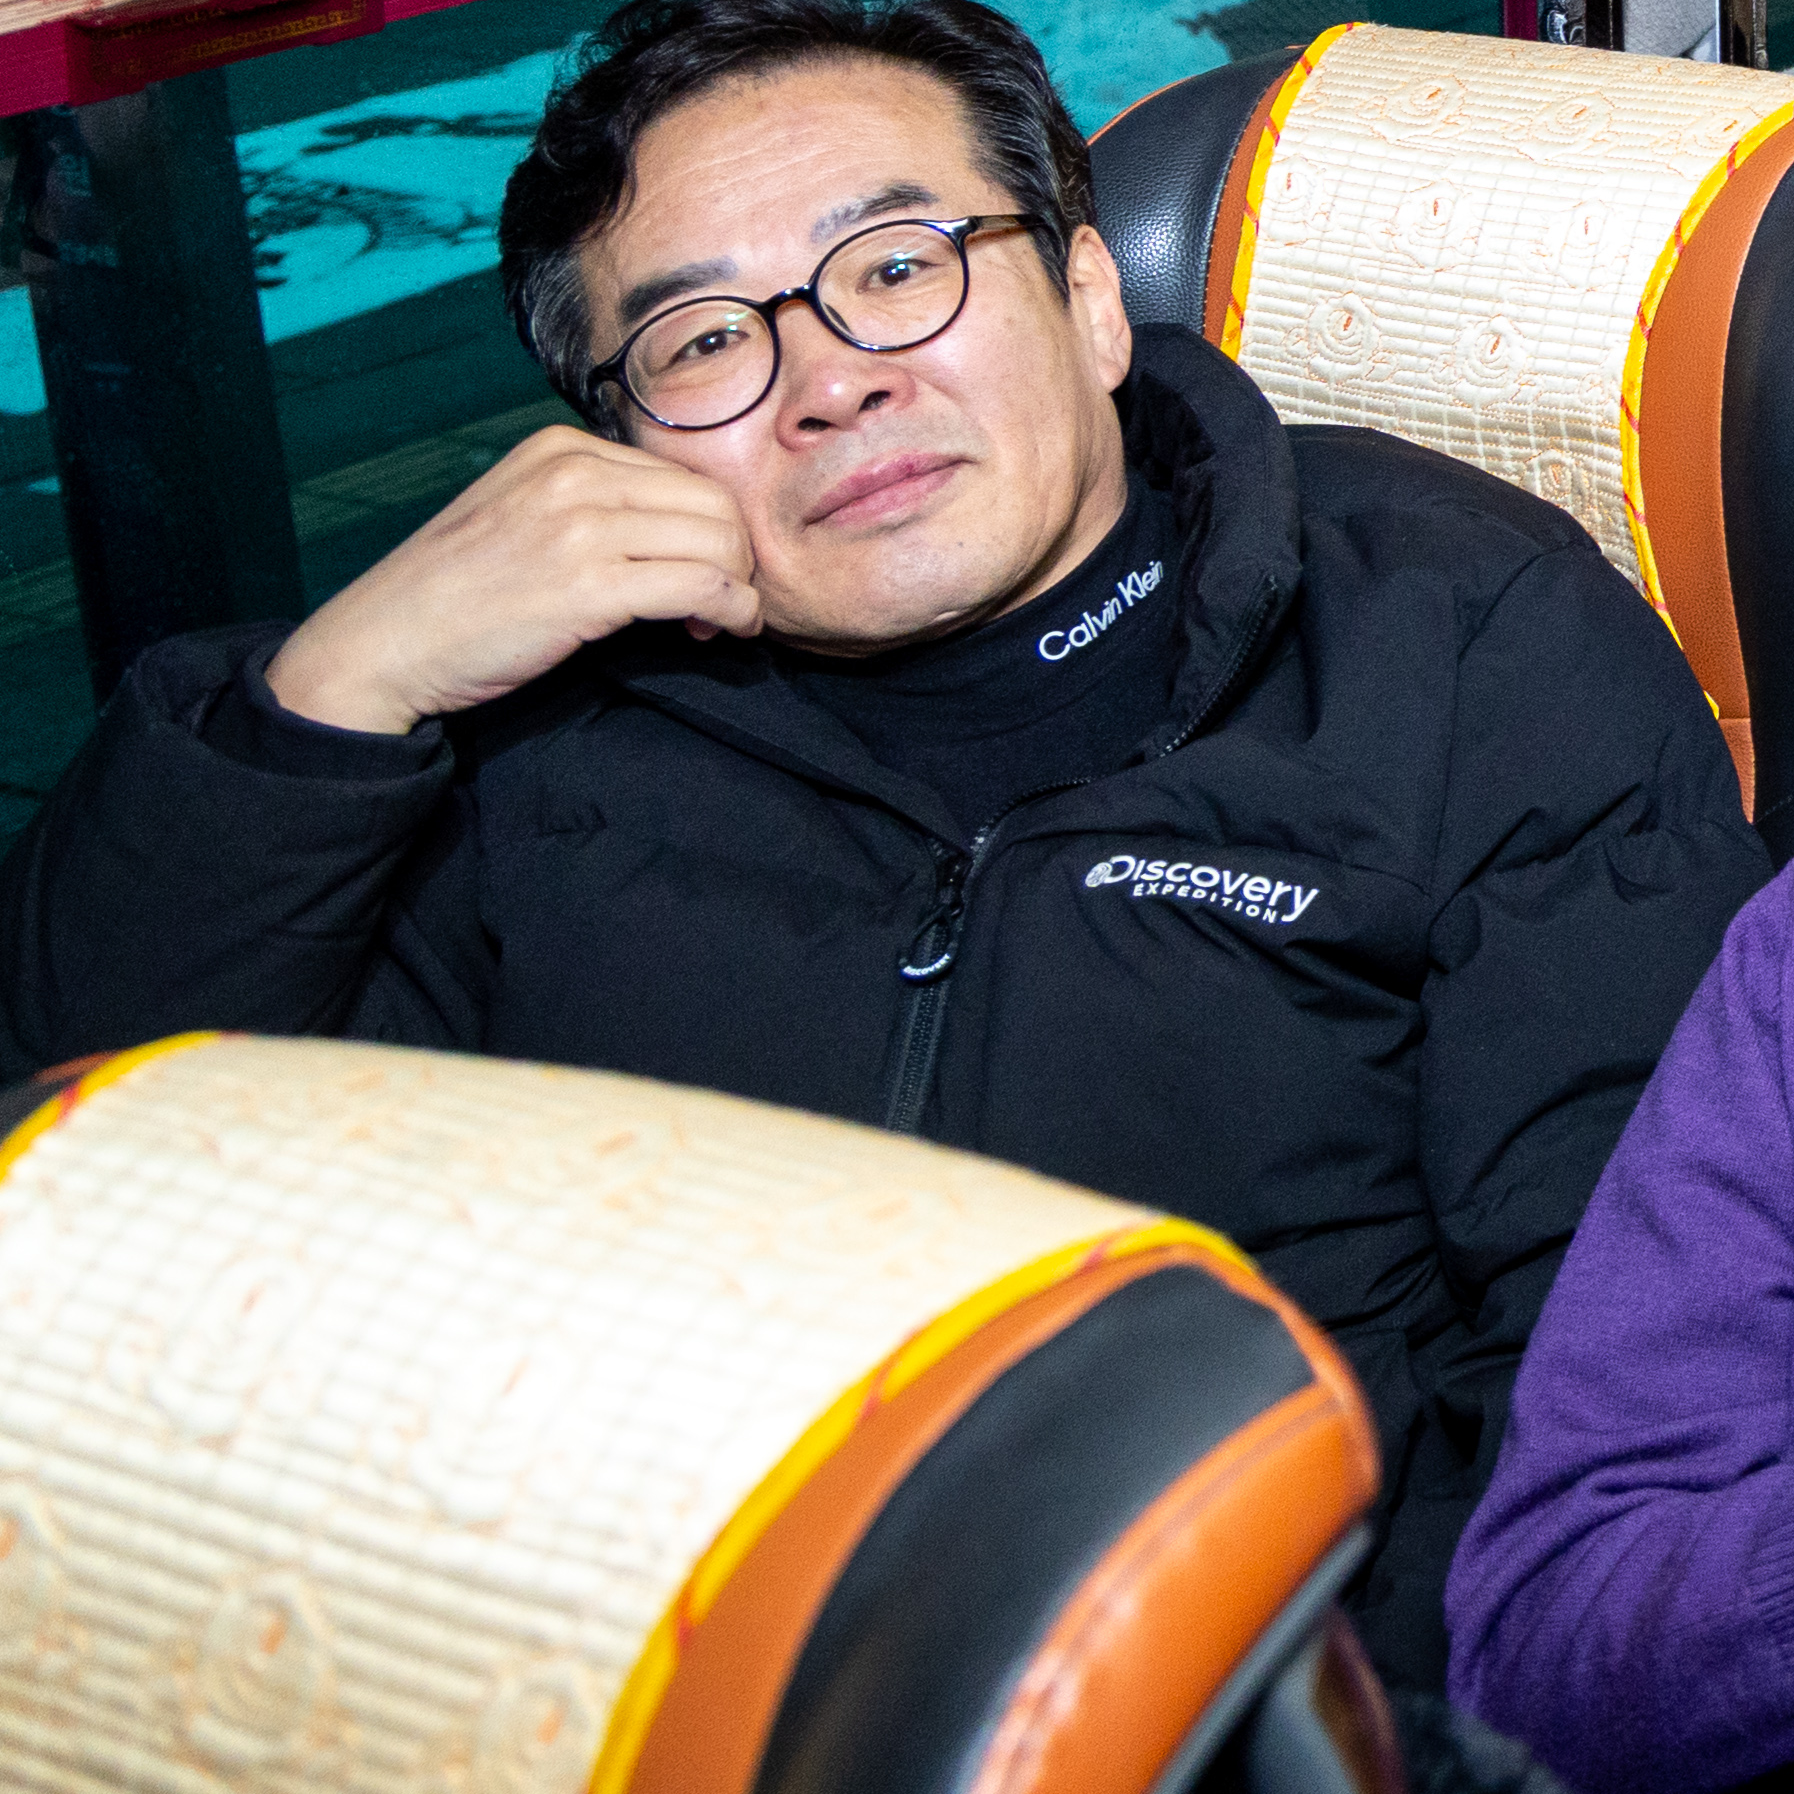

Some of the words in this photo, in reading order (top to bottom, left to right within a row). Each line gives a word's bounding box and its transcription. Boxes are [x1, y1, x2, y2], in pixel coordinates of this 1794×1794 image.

[1038, 597, 1124, 661] Calvin
[1117, 560, 1164, 607] Klein
[1132, 882, 1278, 924] EXPEDITION
